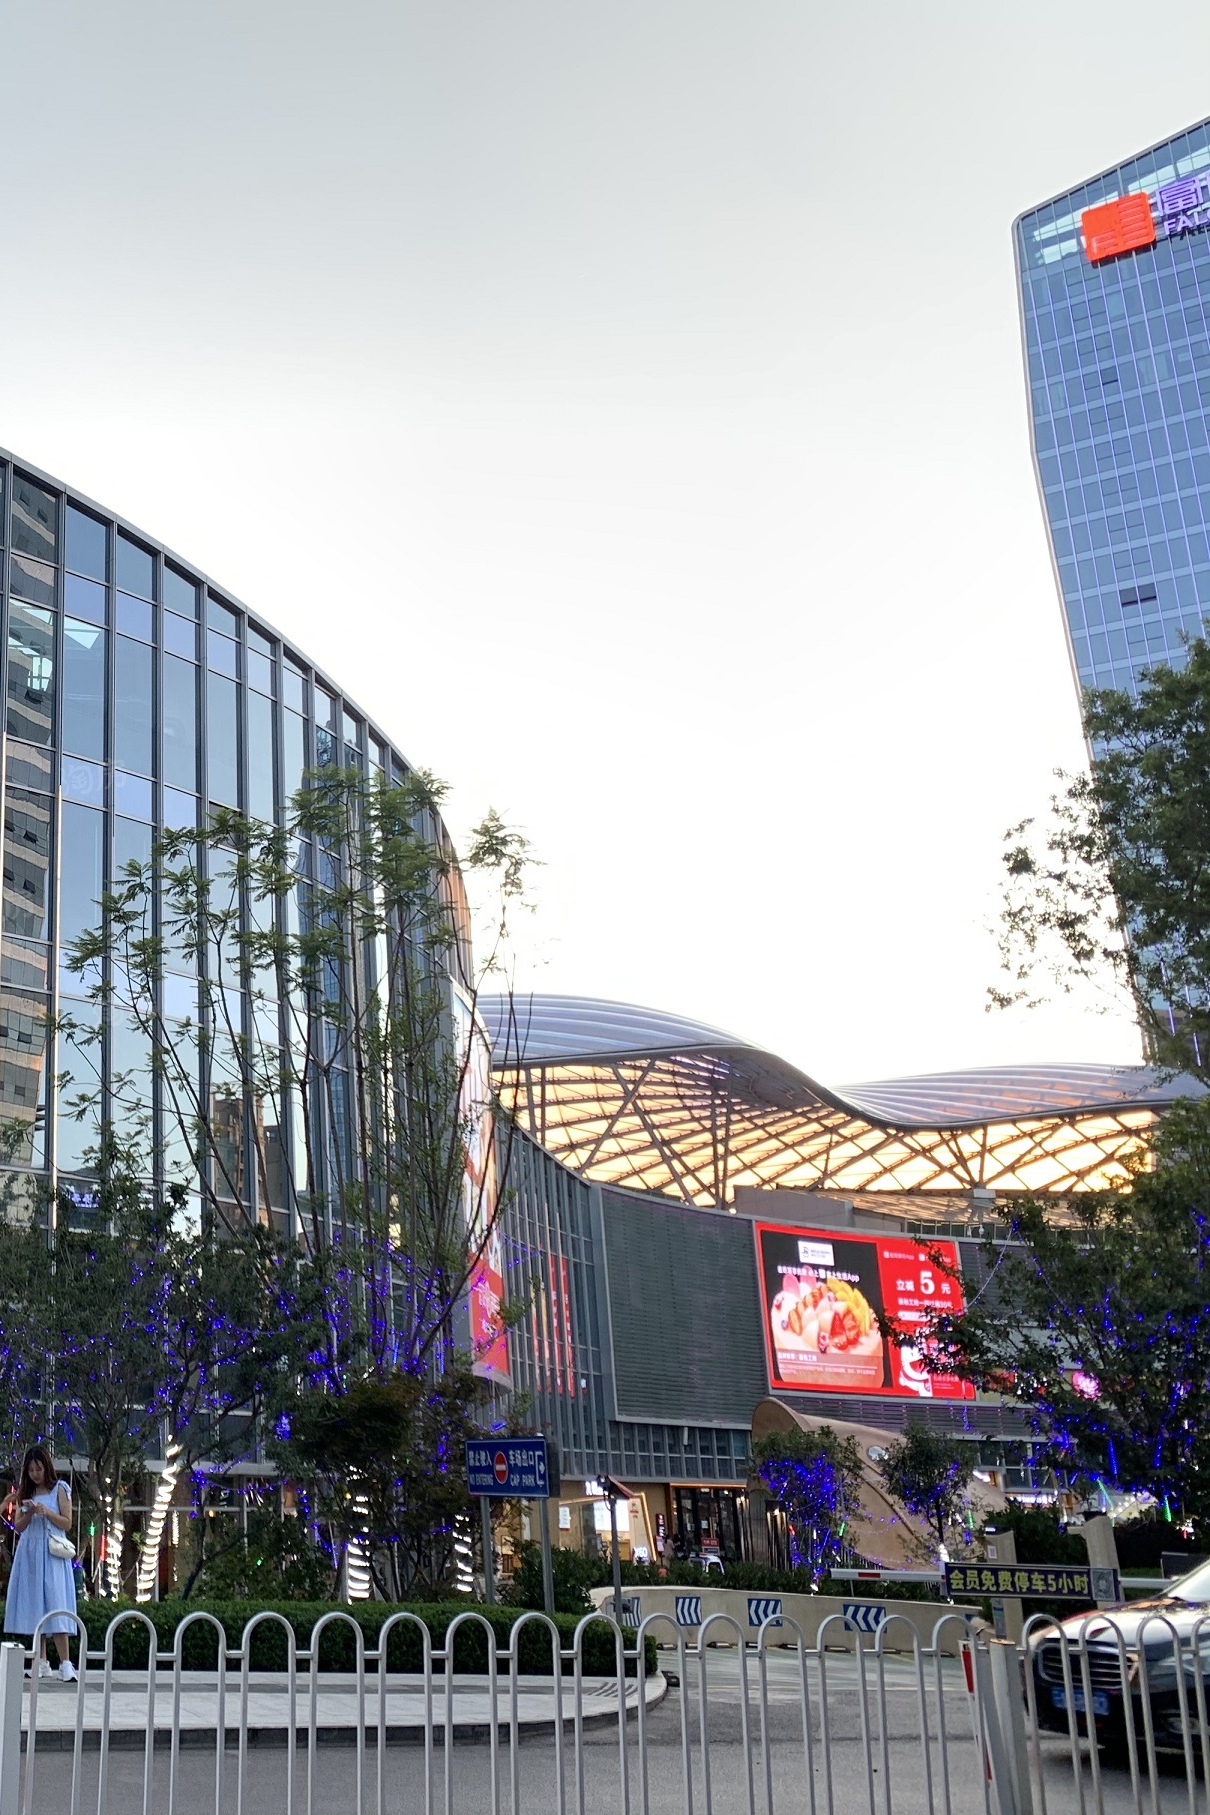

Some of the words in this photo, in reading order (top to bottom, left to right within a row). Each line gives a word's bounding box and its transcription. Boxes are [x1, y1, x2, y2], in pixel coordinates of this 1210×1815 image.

[1155, 170, 1210, 216] 富
[920, 1270, 935, 1295] 5
[941, 1283, 951, 1295] 元
[522, 1474, 536, 1487] PARK
[949, 1569, 1089, 1595] 会员免费停车5小时
